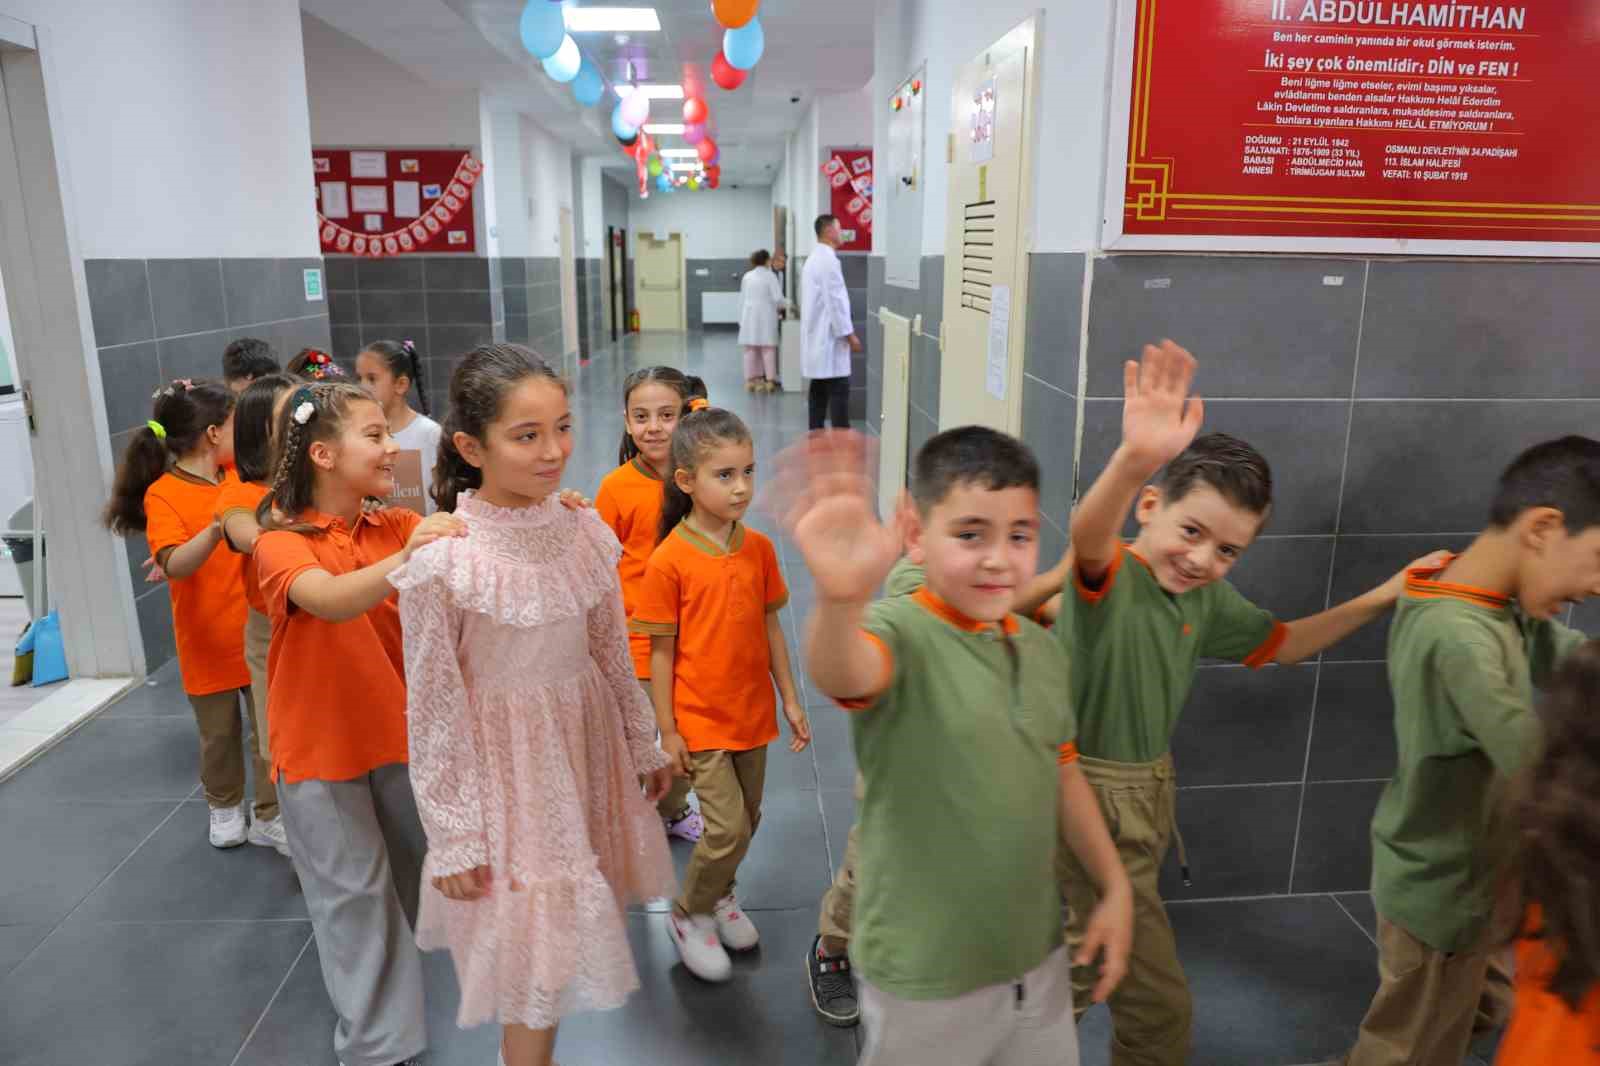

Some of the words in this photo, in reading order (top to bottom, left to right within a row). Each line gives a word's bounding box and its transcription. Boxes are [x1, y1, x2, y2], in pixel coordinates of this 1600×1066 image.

[1271, 0, 1291, 20] II.
[1300, 0, 1525, 29] ABDÜLHAMİTHAN
[1273, 31, 1293, 42] Ben
[1295, 32, 1312, 43] her
[1314, 34, 1354, 45] caminin
[1355, 34, 1394, 47] yanında
[1396, 36, 1411, 47] bir
[1413, 37, 1434, 48] okul
[1436, 38, 1475, 51] görmek
[1477, 39, 1515, 51] isterim.
[1264, 49, 1284, 68] İki
[1287, 56, 1313, 72] şey
[1316, 56, 1343, 71] çok
[1346, 56, 1424, 73] önemlidir:
[1428, 56, 1454, 74] DİN
[1458, 63, 1475, 75] ve
[1478, 61, 1509, 76] FEN
[1281, 76, 1303, 87] Beni
[1361, 80, 1394, 91] etseler,
[1396, 81, 1422, 91] evimi
[1424, 82, 1457, 94] başıma
[1459, 83, 1497, 95] yıksalar,
[1328, 91, 1362, 102] benden
[1364, 93, 1397, 103] alsalar
[1398, 94, 1435, 105] Hakkımı
[1462, 96, 1501, 106] Ederdim
[1257, 101, 1283, 111] Lâkin
[1285, 102, 1331, 113] Devletime
[1333, 104, 1390, 116] saldıranlara,
[1392, 107, 1457, 117] mukaddesime
[1459, 109, 1514, 120] saldıranlara,
[1276, 115, 1312, 125] bunlara
[1313, 117, 1354, 128] uyanlara
[1356, 118, 1393, 128] Hakkımı
[1429, 119, 1488, 131] ETMİYORUM
[1245, 135, 1282, 145] DOĞUMU
[1293, 137, 1302, 146] 21
[1304, 136, 1329, 147] EYLÜL
[1385, 144, 1421, 155] OSMANLI
[1244, 156, 1274, 165] BABASI
[1346, 159, 1363, 168] HAN
[1400, 156, 1425, 168] İSLAM
[1426, 157, 1461, 169] HALİFESİ
[1337, 168, 1366, 177] SULTAN
[1423, 170, 1449, 181] ŞUBAT
